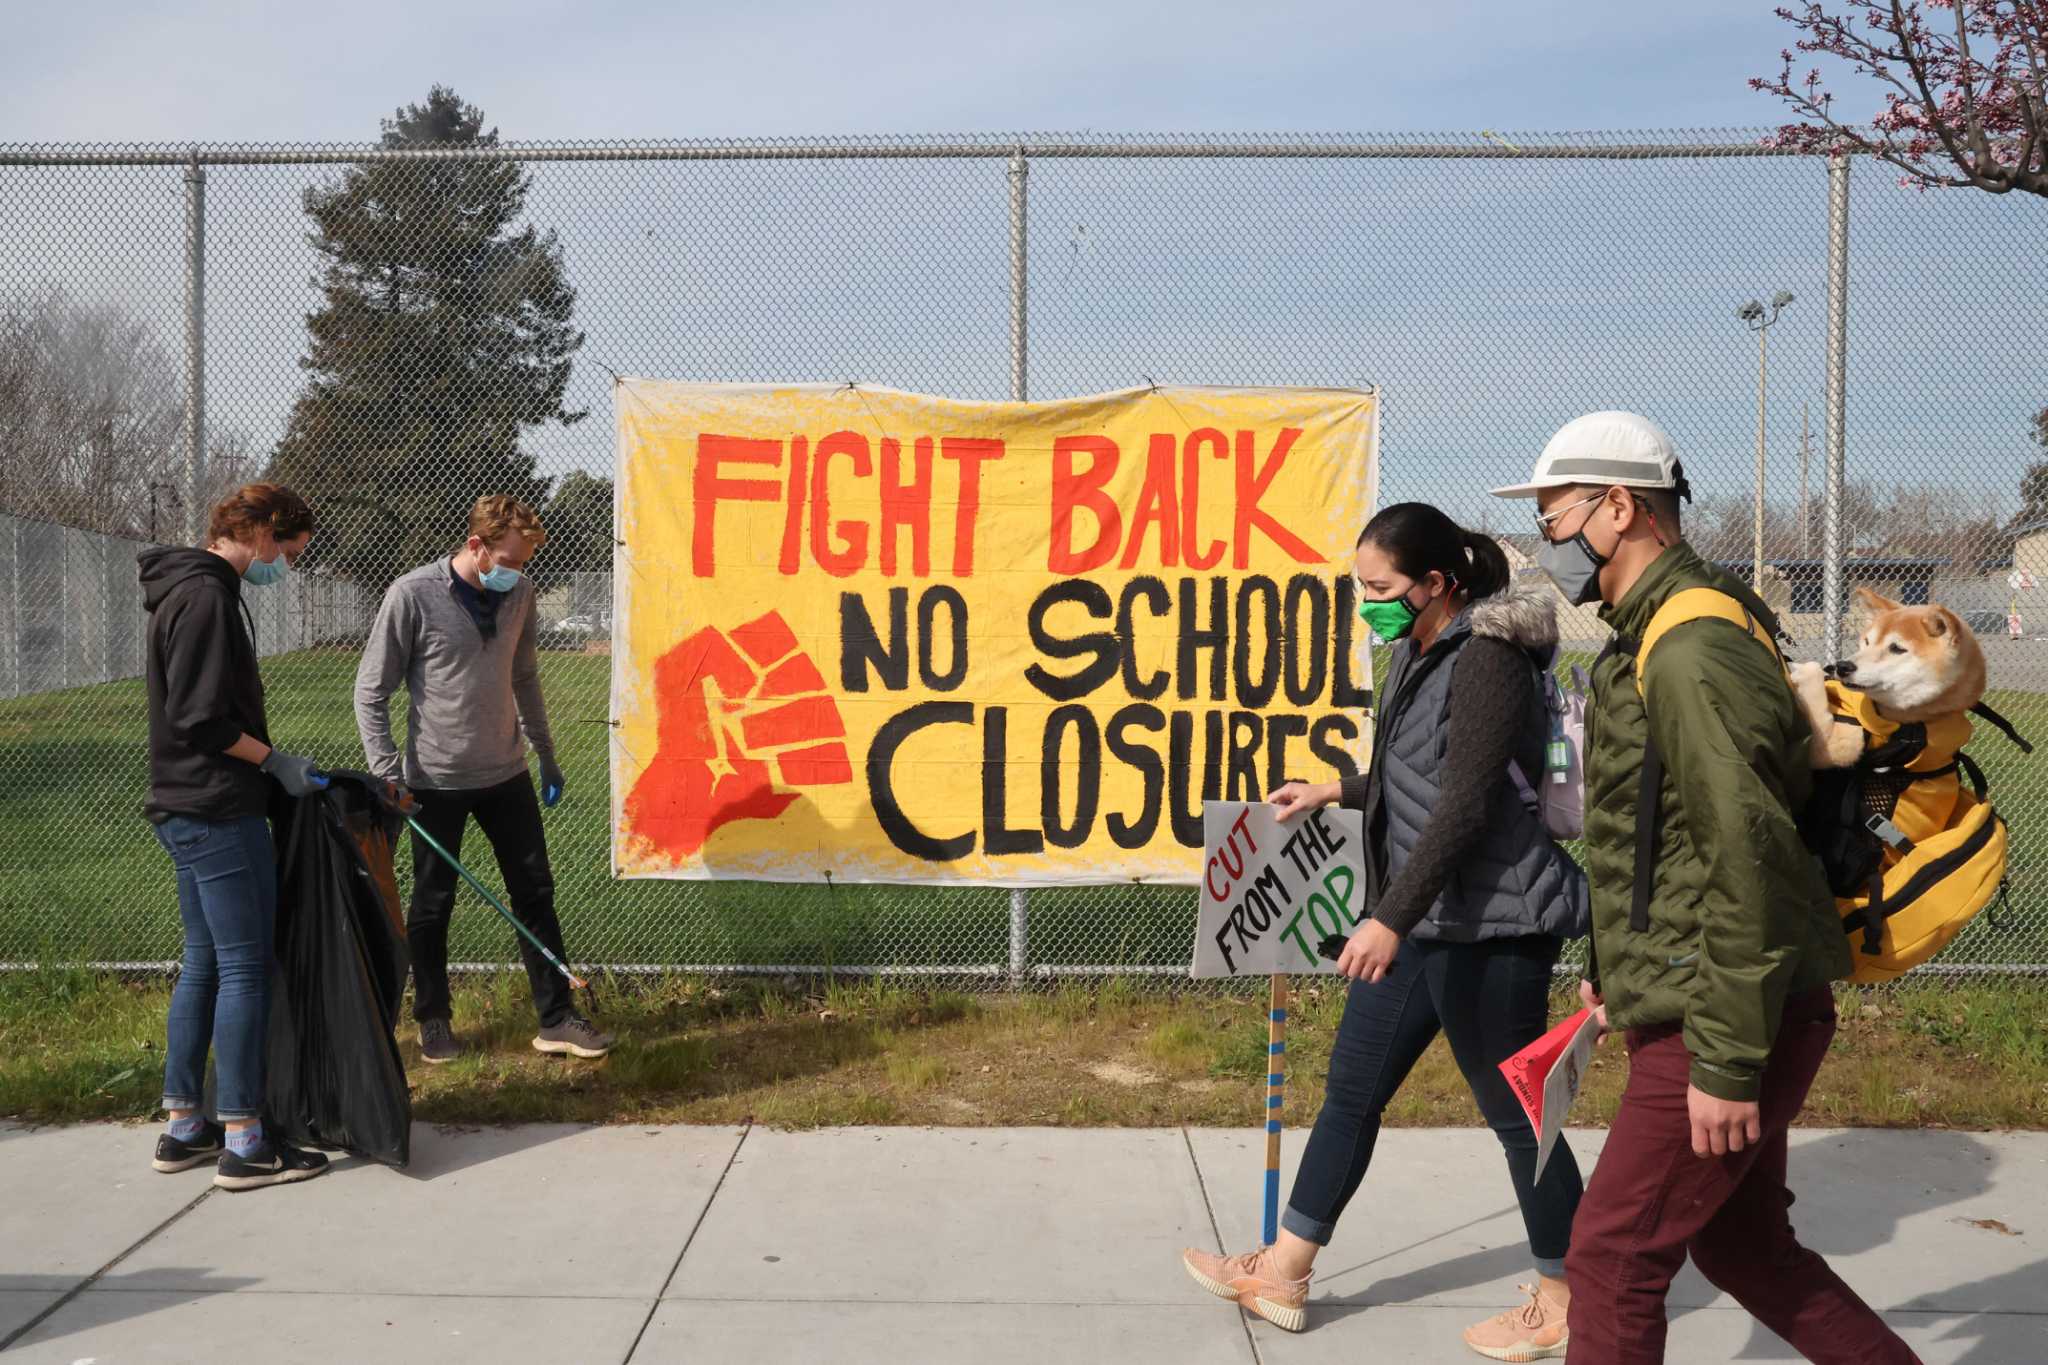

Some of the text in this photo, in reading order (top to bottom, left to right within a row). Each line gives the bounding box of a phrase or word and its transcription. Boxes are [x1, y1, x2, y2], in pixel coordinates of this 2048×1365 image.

[692, 427, 1330, 578] FIGHT BACK
[839, 572, 1374, 708] NO SCHOOL
[1206, 806, 1258, 902] CUT
[1215, 807, 1346, 974] FROM THE
[1279, 865, 1355, 968] TOP
